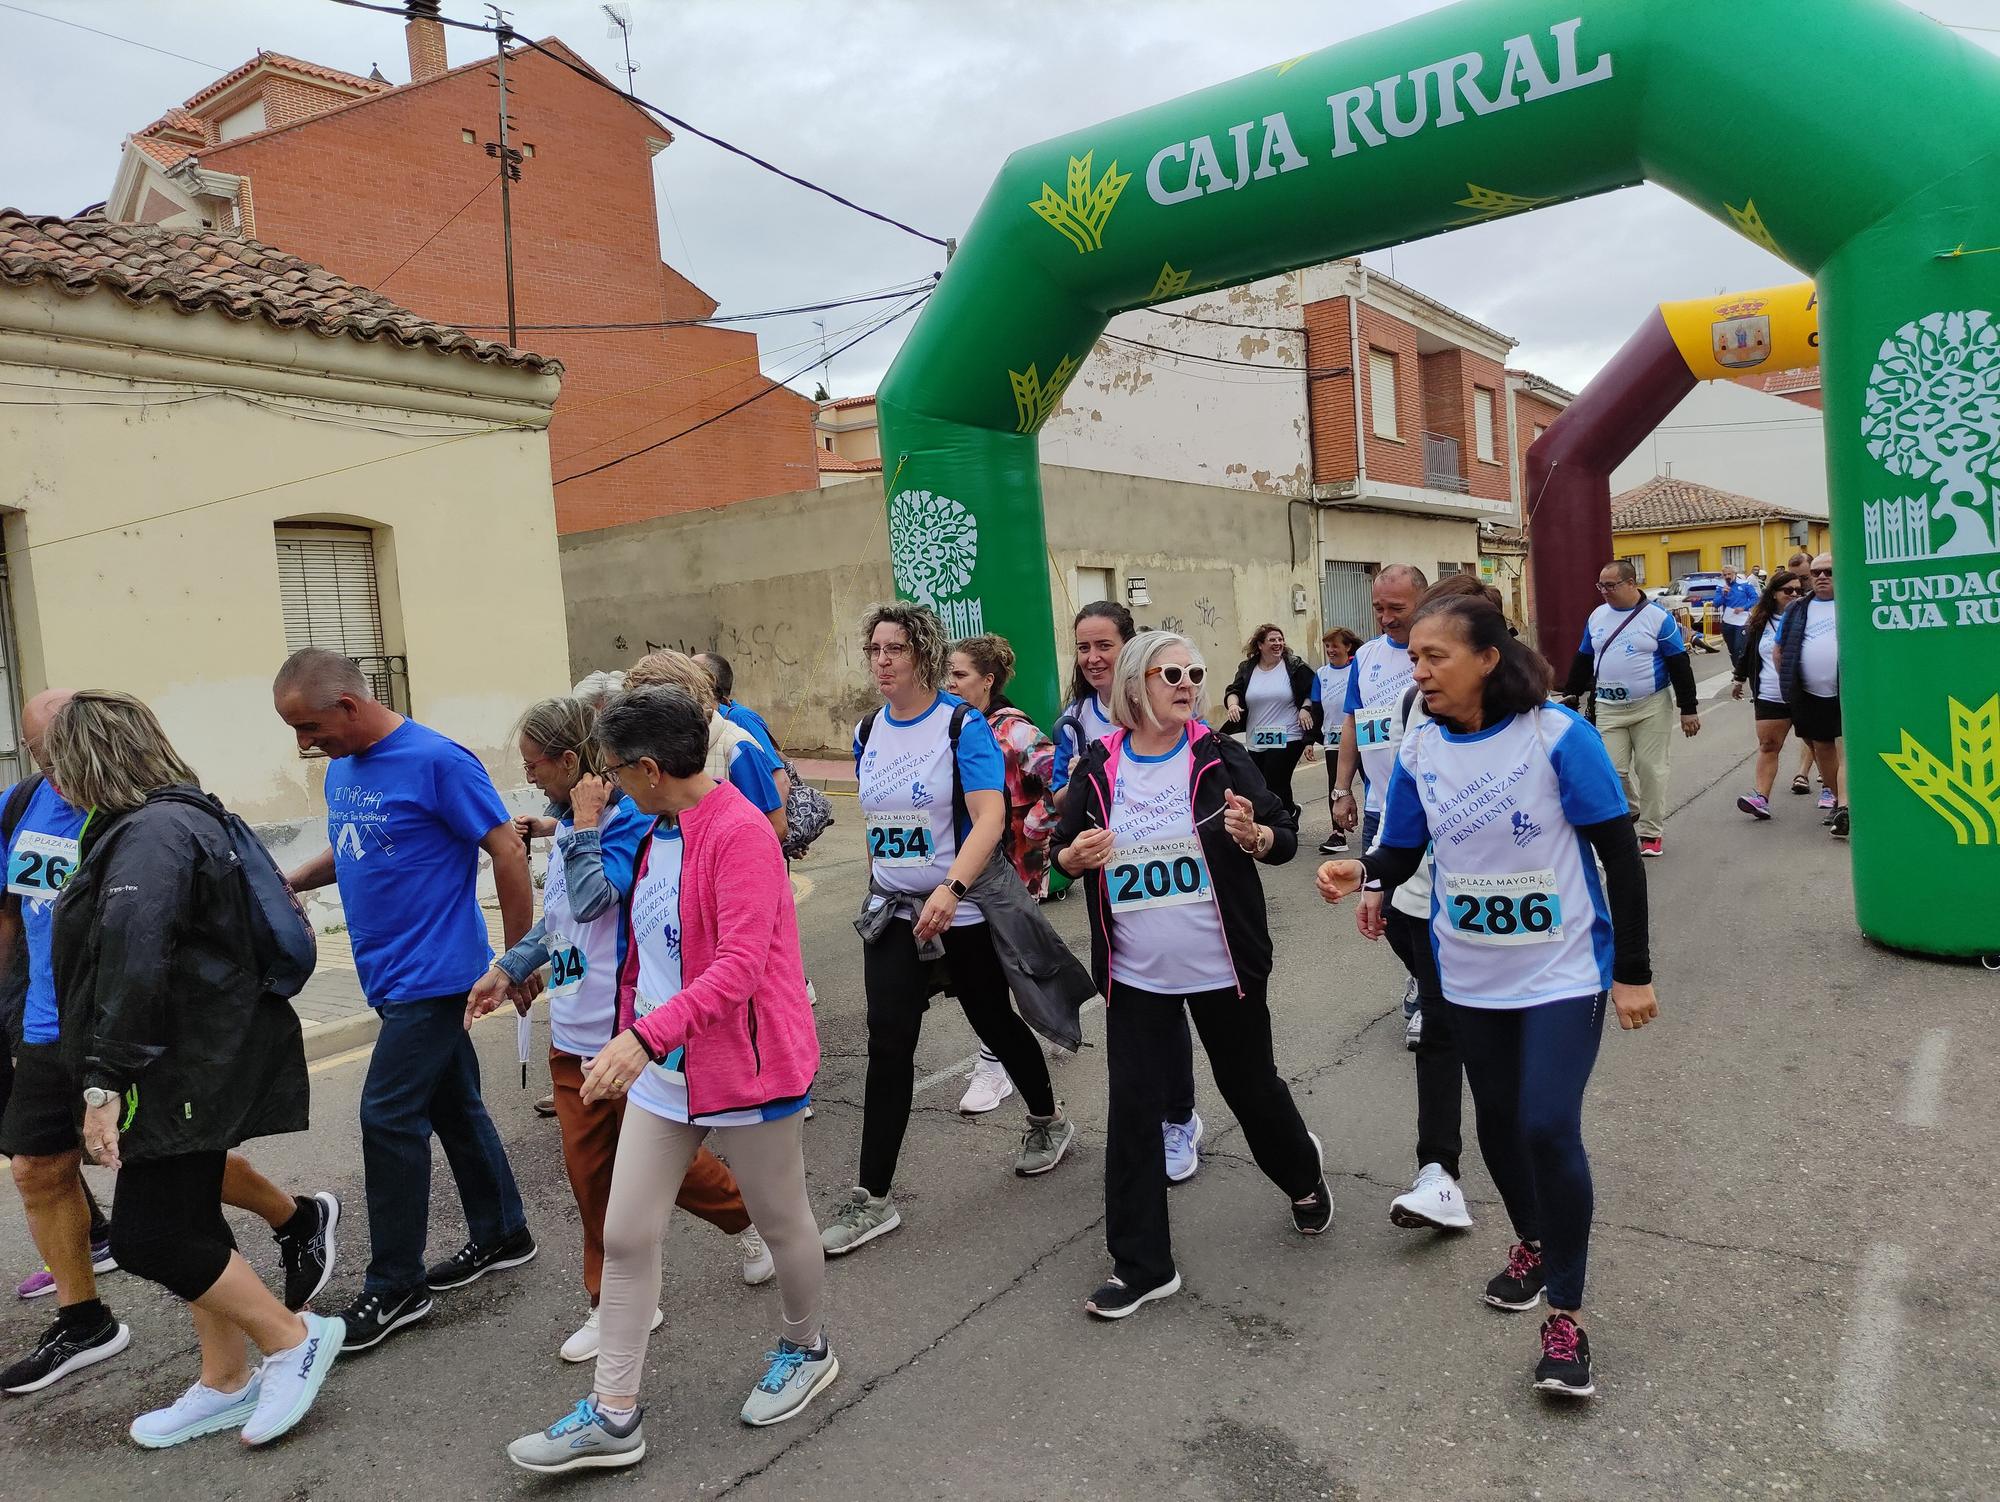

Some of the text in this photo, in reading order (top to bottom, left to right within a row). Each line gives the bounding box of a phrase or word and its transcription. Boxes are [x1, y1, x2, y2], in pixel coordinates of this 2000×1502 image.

[1145, 17, 1613, 206] CAJA RURAL
[1872, 603, 1947, 631] CAJA
[1256, 732, 1283, 745] 251
[870, 751, 913, 783] MEMORIAL
[873, 769, 921, 804] BENAVENTE
[1438, 771, 1497, 817] MEMORIAL
[1450, 794, 1518, 846] BENAVENTE
[35, 836, 62, 848] PLAZA
[871, 826, 929, 859] 254
[1120, 845, 1150, 857] PLAZA
[1152, 841, 1186, 852] MAYOR
[1114, 856, 1201, 902] 200
[1460, 875, 1536, 888] PLAZA MAYOR
[1453, 892, 1553, 935] 286
[297, 1337, 320, 1380] HOKA
